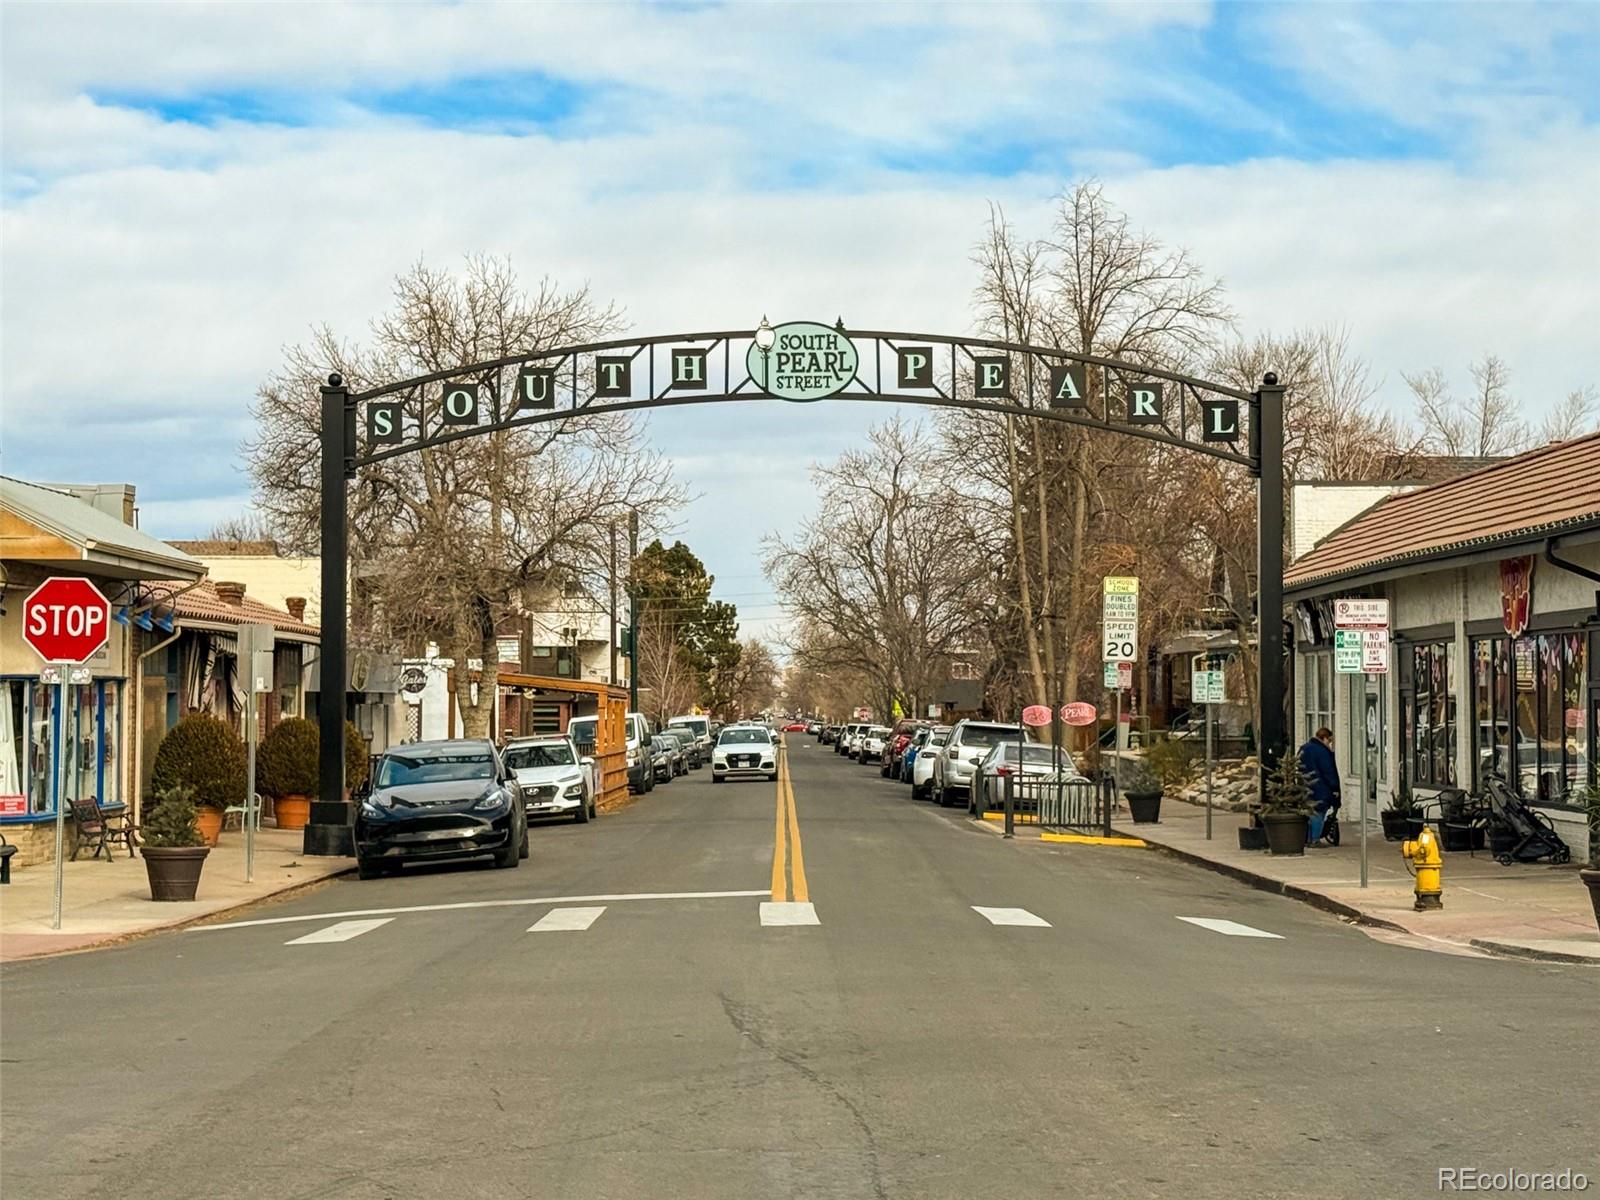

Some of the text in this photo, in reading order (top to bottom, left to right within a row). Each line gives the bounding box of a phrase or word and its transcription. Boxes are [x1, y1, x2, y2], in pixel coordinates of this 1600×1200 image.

[780, 334, 838, 350] SOUTH
[776, 351, 852, 381] PEARL
[776, 376, 832, 391] STREET
[1108, 579, 1135, 587] SCHOOL
[1110, 595, 1132, 603] FINES
[1106, 602, 1136, 610] DOUBLED
[29, 604, 103, 637] STOP
[1106, 623, 1135, 631] SPEED
[1109, 632, 1131, 640] LIMIT
[1369, 632, 1380, 641] NO
[1106, 641, 1134, 657] 20
[1363, 641, 1386, 649] PARKING
